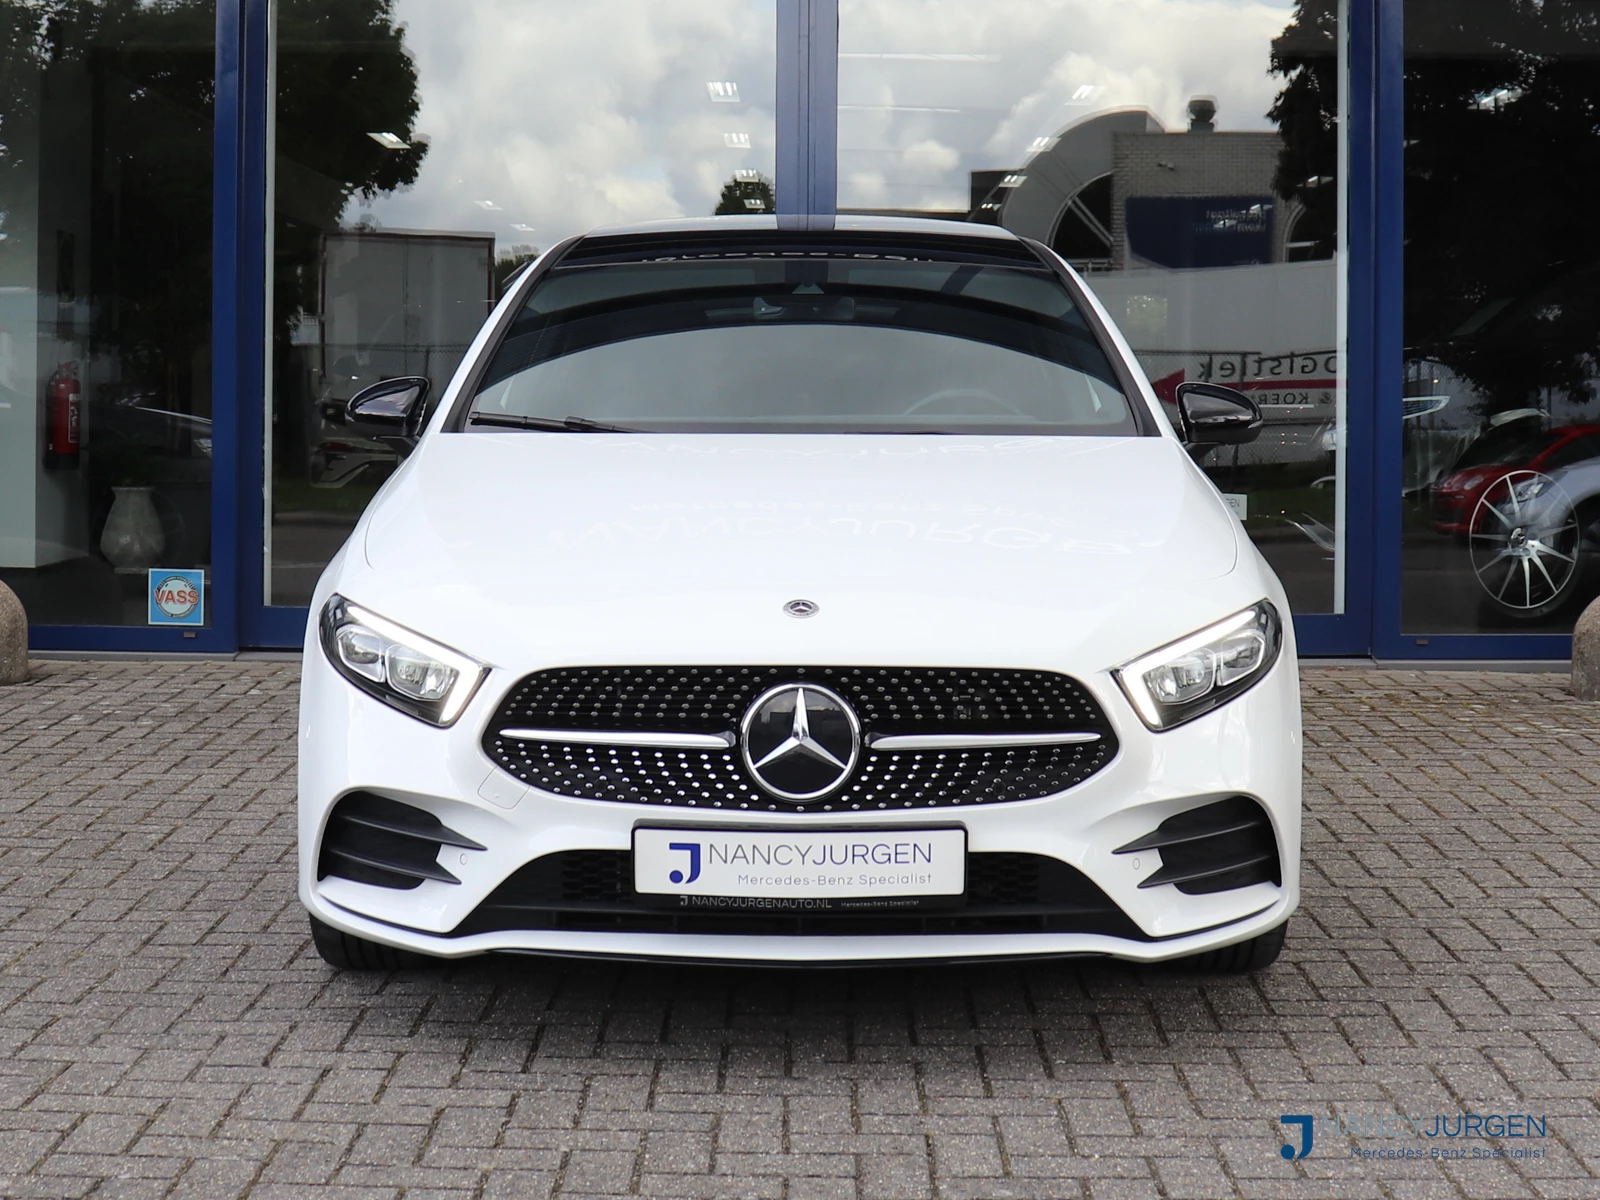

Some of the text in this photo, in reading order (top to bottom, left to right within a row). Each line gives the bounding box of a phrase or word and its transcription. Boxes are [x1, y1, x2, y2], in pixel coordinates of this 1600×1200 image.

[154, 589, 199, 605] VASS
[708, 842, 932, 866] NANCYJURGEN
[737, 873, 932, 887] Mercedes-Benz Specialist
[692, 896, 832, 909] NANCYJURGENAUTO.NL
